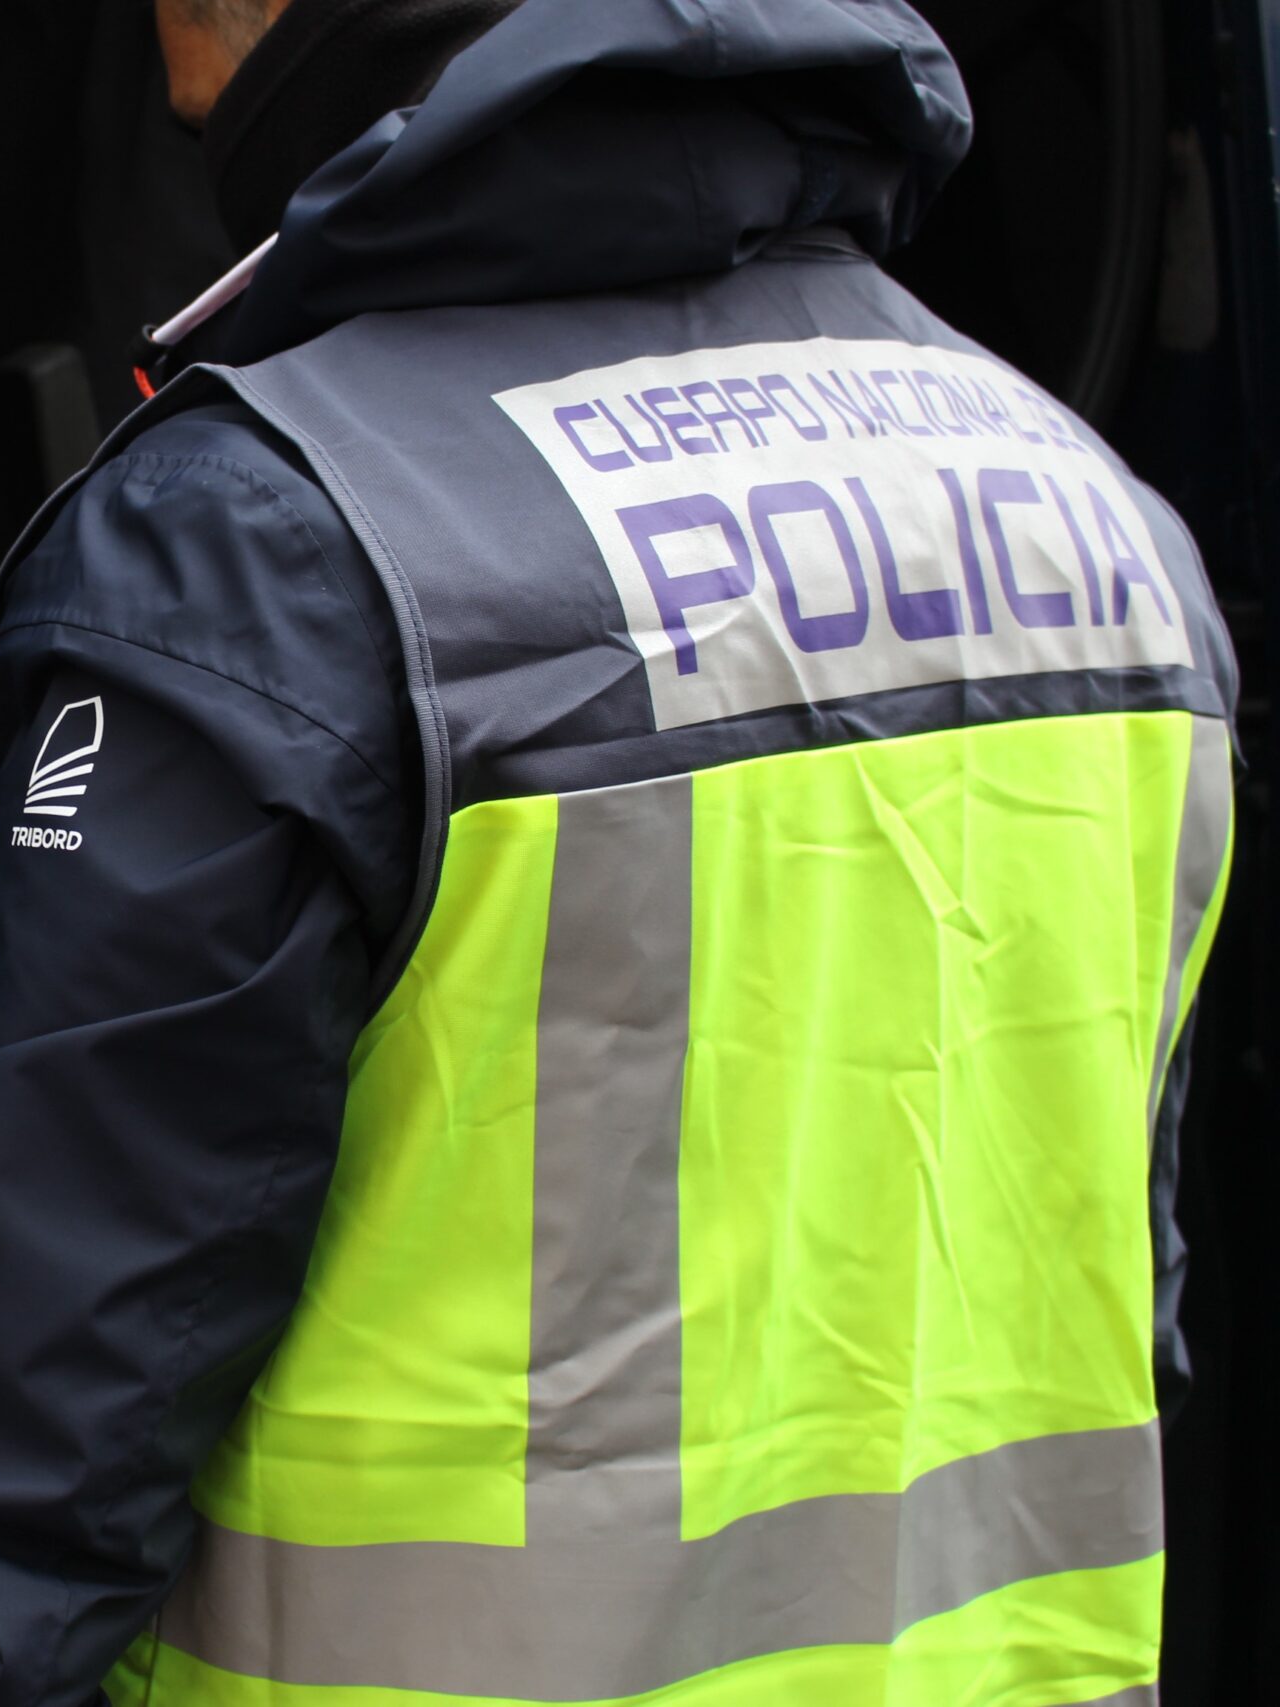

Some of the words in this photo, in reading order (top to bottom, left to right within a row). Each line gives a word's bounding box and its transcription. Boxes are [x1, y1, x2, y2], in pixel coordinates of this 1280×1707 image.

[553, 373, 829, 472] CUERPO
[614, 468, 1173, 675] POLICIA
[11, 826, 83, 851] TRIBORD
